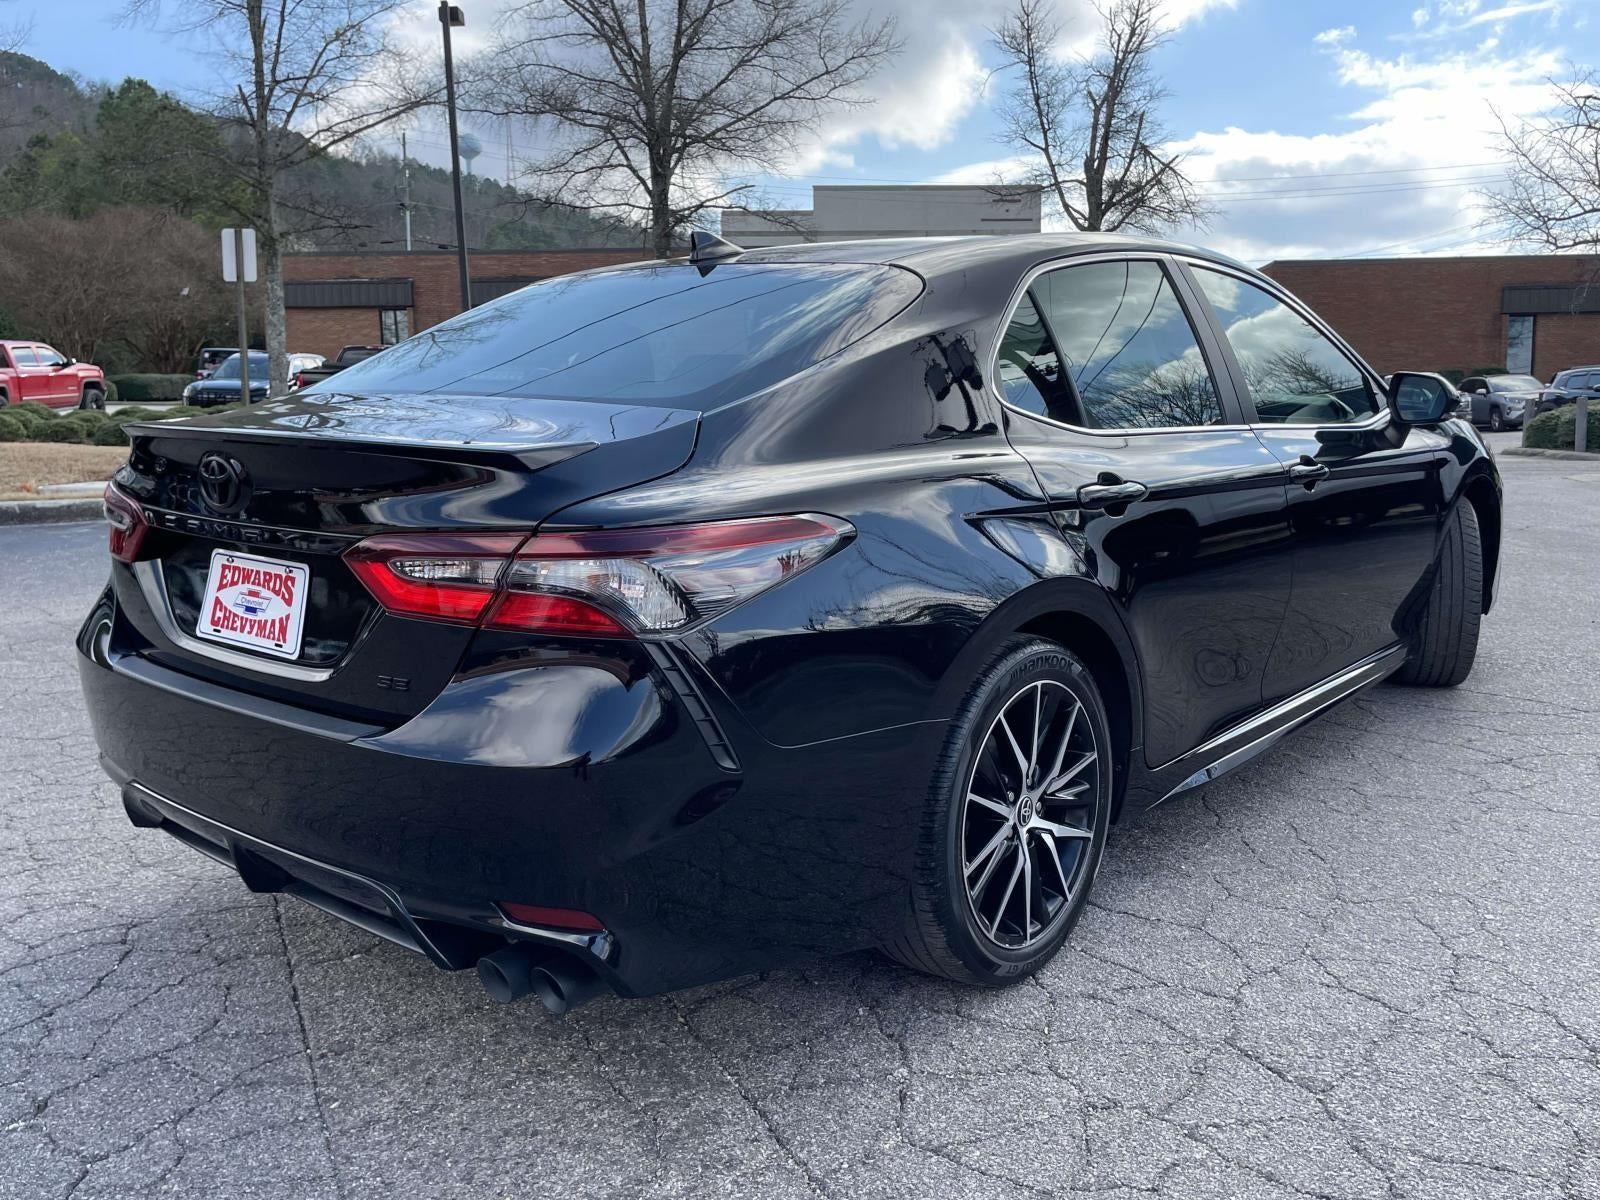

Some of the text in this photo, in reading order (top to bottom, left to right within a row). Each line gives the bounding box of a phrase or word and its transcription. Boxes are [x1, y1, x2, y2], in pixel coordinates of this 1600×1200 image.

[217, 563, 296, 608] EDWARDS
[210, 595, 291, 644] CHEVYMAN
[376, 674, 409, 690] SE
